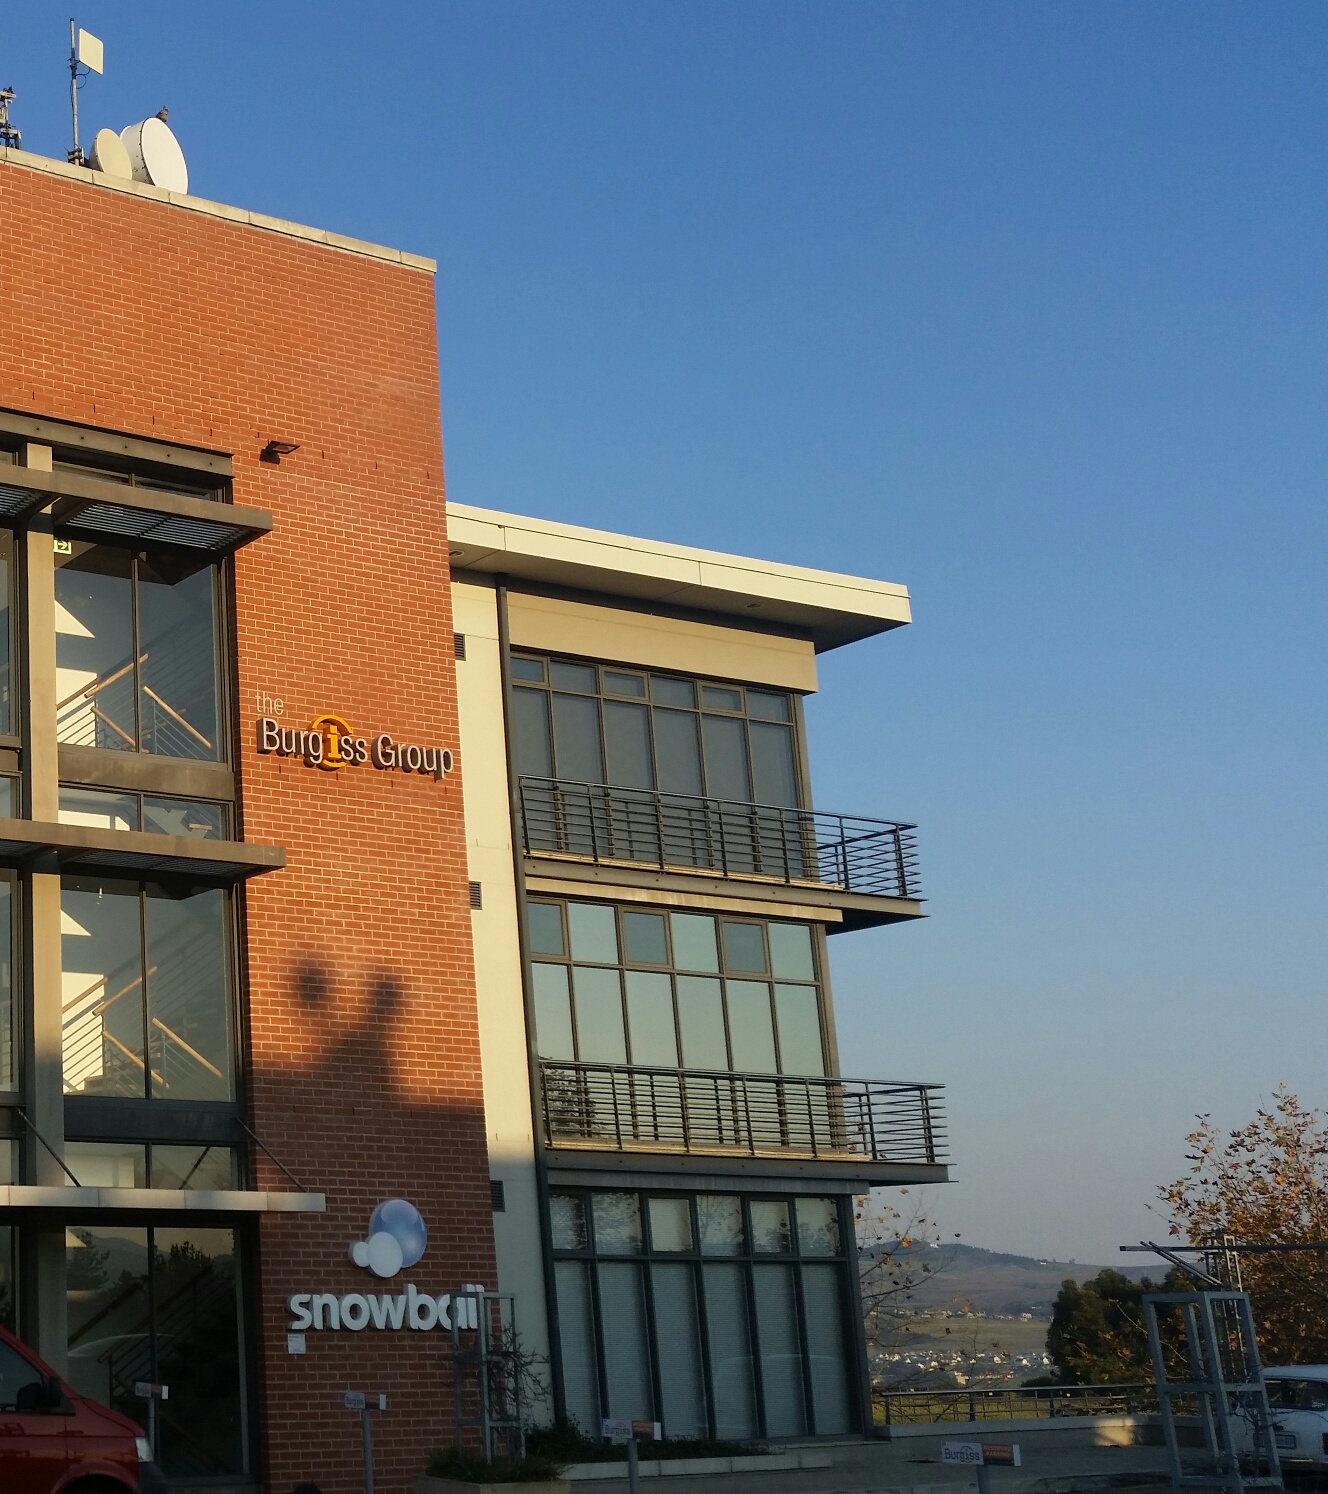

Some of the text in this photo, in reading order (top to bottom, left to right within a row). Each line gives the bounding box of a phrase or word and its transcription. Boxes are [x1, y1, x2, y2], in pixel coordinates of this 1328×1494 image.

[255, 691, 284, 716] the
[260, 717, 454, 780] Burgiss Group
[289, 1283, 484, 1331] snowball
[944, 1447, 980, 1462] Burgiss
